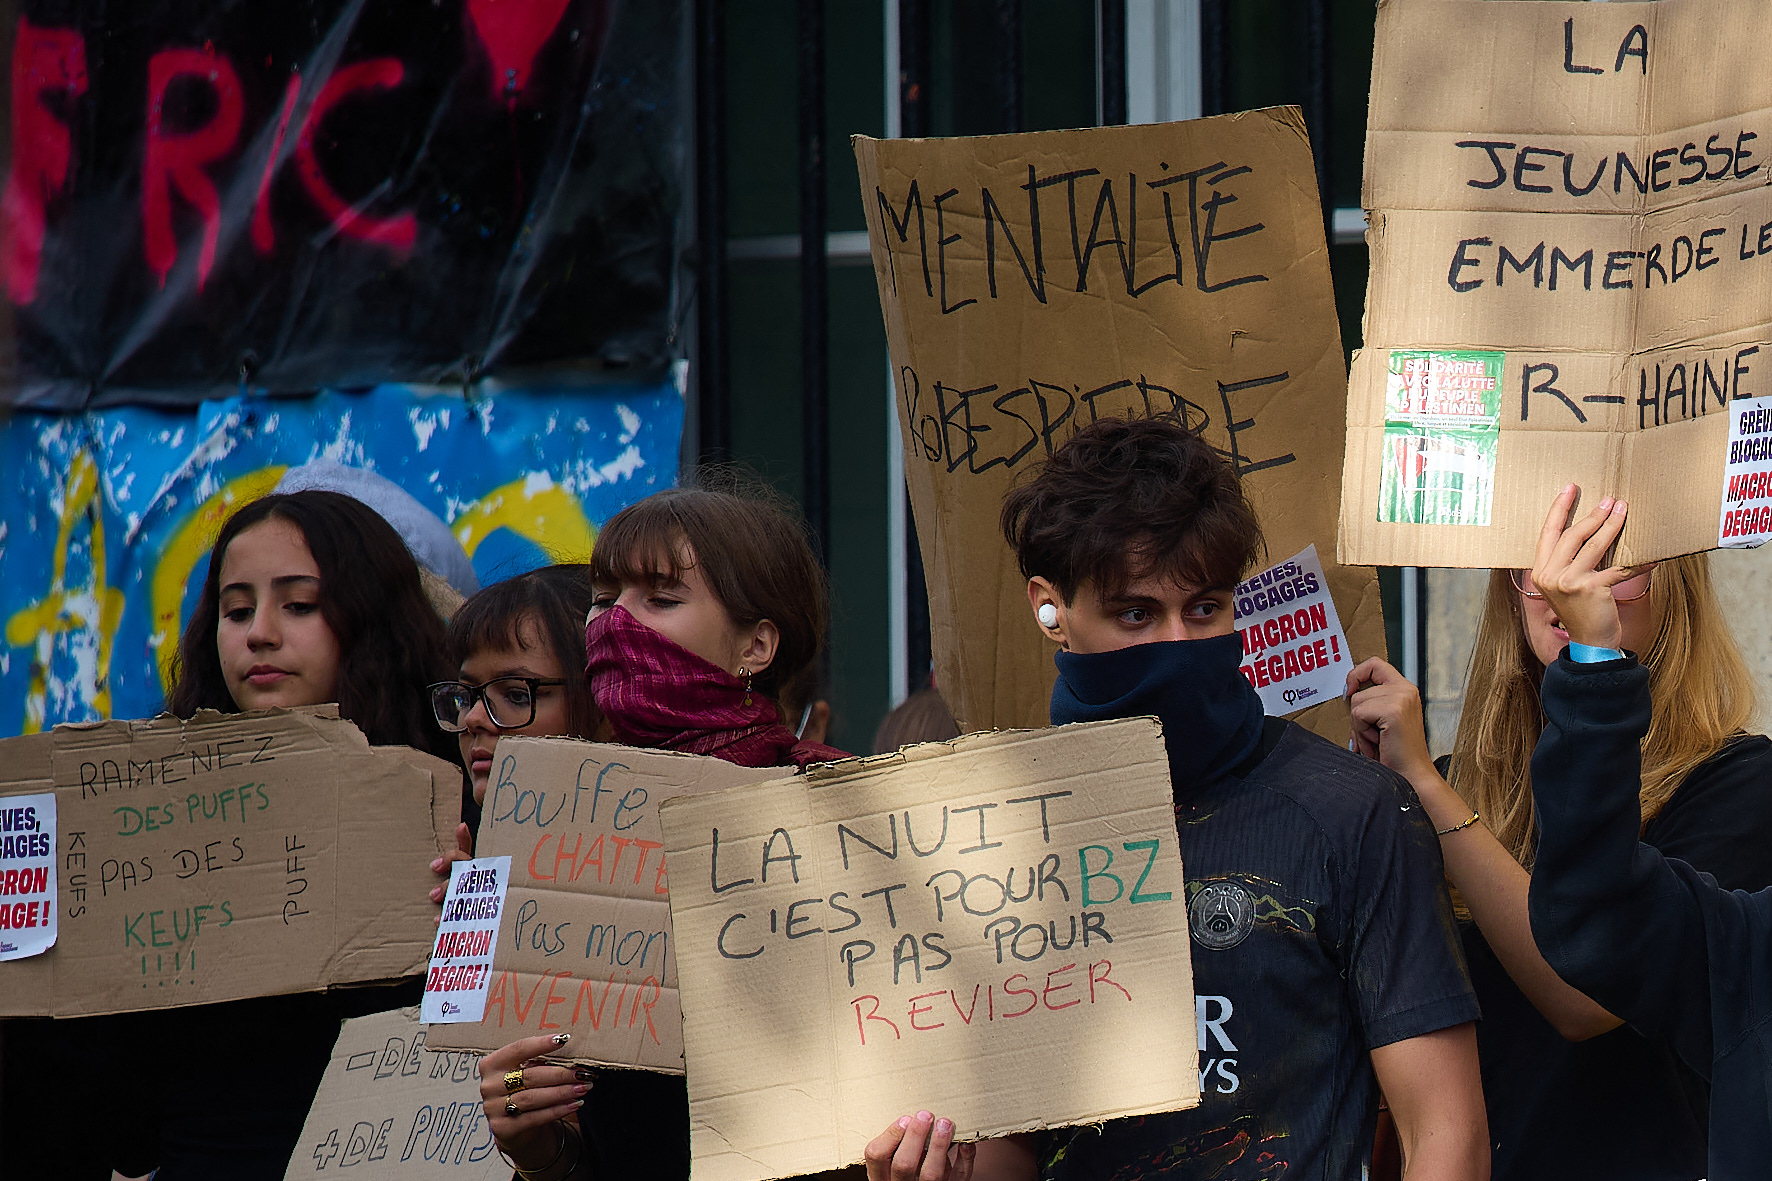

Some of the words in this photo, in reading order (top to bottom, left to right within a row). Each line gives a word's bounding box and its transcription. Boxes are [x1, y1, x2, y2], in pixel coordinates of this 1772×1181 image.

[1564, 17, 1647, 76] LA
[1455, 130, 1761, 196] JEUNESSE
[1448, 226, 1727, 292] EMMERDE
[1404, 360, 1484, 375] SOLDARITÉ
[80, 735, 276, 800] RAMENEZ
[113, 803, 175, 838] DES
[187, 781, 271, 824] PUFFS
[101, 856, 154, 897] PAS
[172, 836, 245, 880] DES
[710, 827, 802, 894] LA
[838, 791, 1075, 869] NUIT
[66, 831, 88, 919] KEUFS
[456, 863, 499, 895] GRÈVES,
[718, 882, 906, 960] C'EST
[927, 853, 1070, 924] POUR
[1077, 838, 1173, 907] BZ
[123, 900, 235, 949] KEUFS
[443, 896, 501, 922] BLOCAGES
[434, 930, 494, 958] MACRON
[515, 899, 571, 957] Pas
[586, 923, 668, 987] mon
[841, 931, 953, 988] PAS
[984, 911, 1114, 965] POUR
